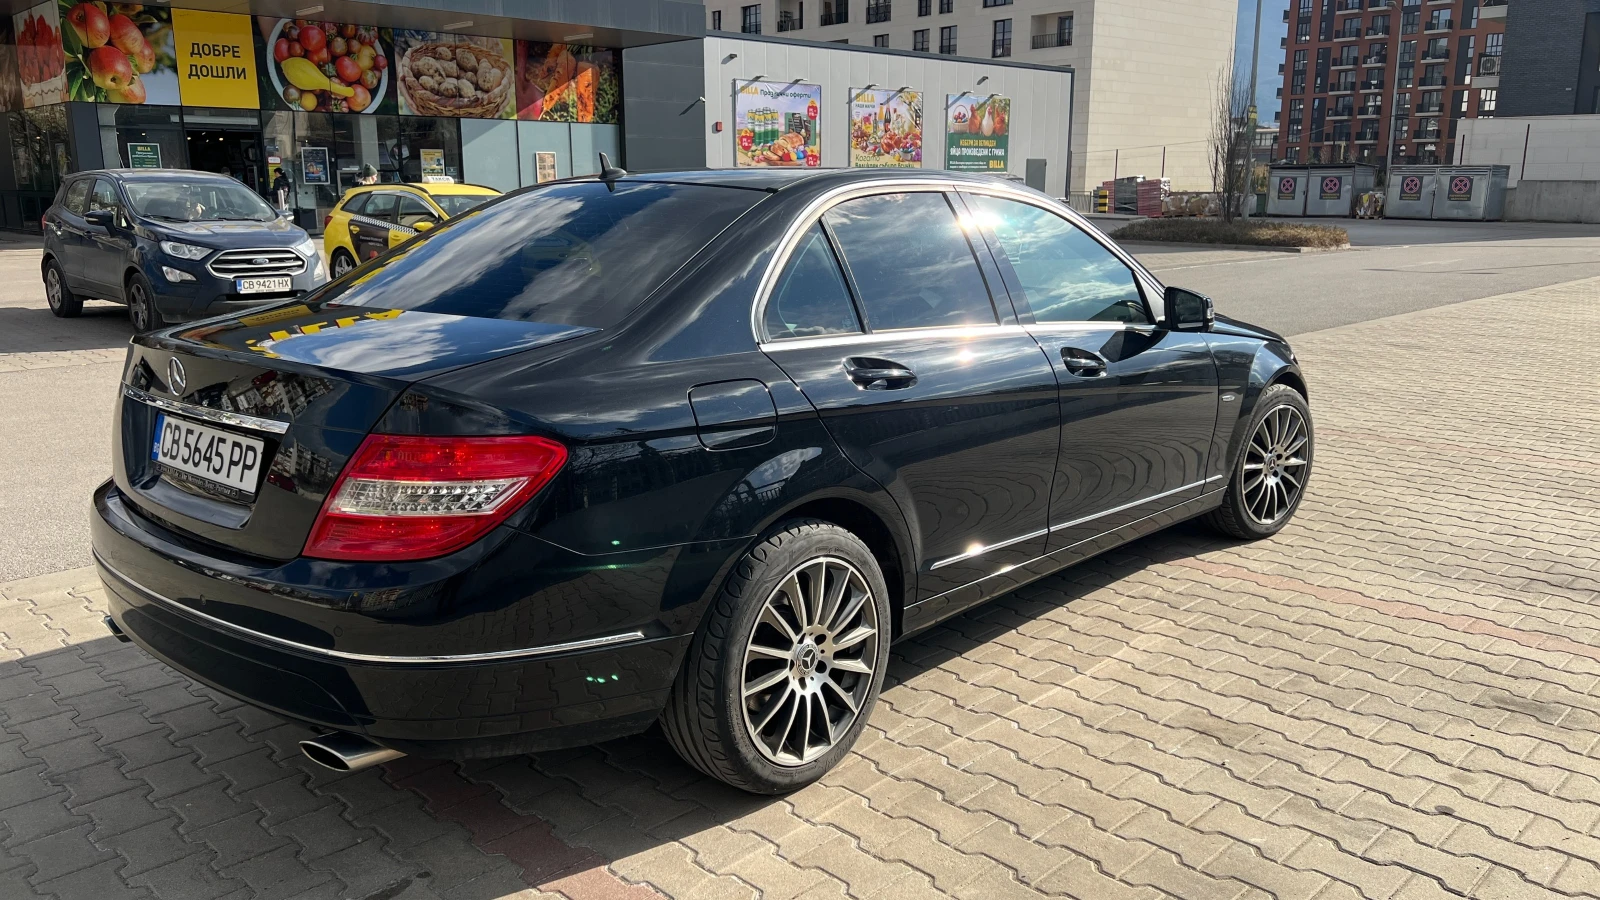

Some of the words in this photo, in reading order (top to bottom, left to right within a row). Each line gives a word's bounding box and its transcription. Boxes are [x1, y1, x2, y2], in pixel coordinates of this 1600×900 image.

[190, 42, 241, 58] ДОБРЕ
[188, 64, 247, 80] ДОШЛИ
[741, 86, 759, 95] BILLA
[856, 93, 875, 103] BILLA
[989, 160, 1004, 168] BILLA
[242, 280, 255, 290] CB
[256, 279, 277, 289] 9421
[277, 278, 290, 288] HX
[161, 422, 182, 461] CB
[181, 428, 227, 475] 5645
[226, 440, 258, 483] PP
